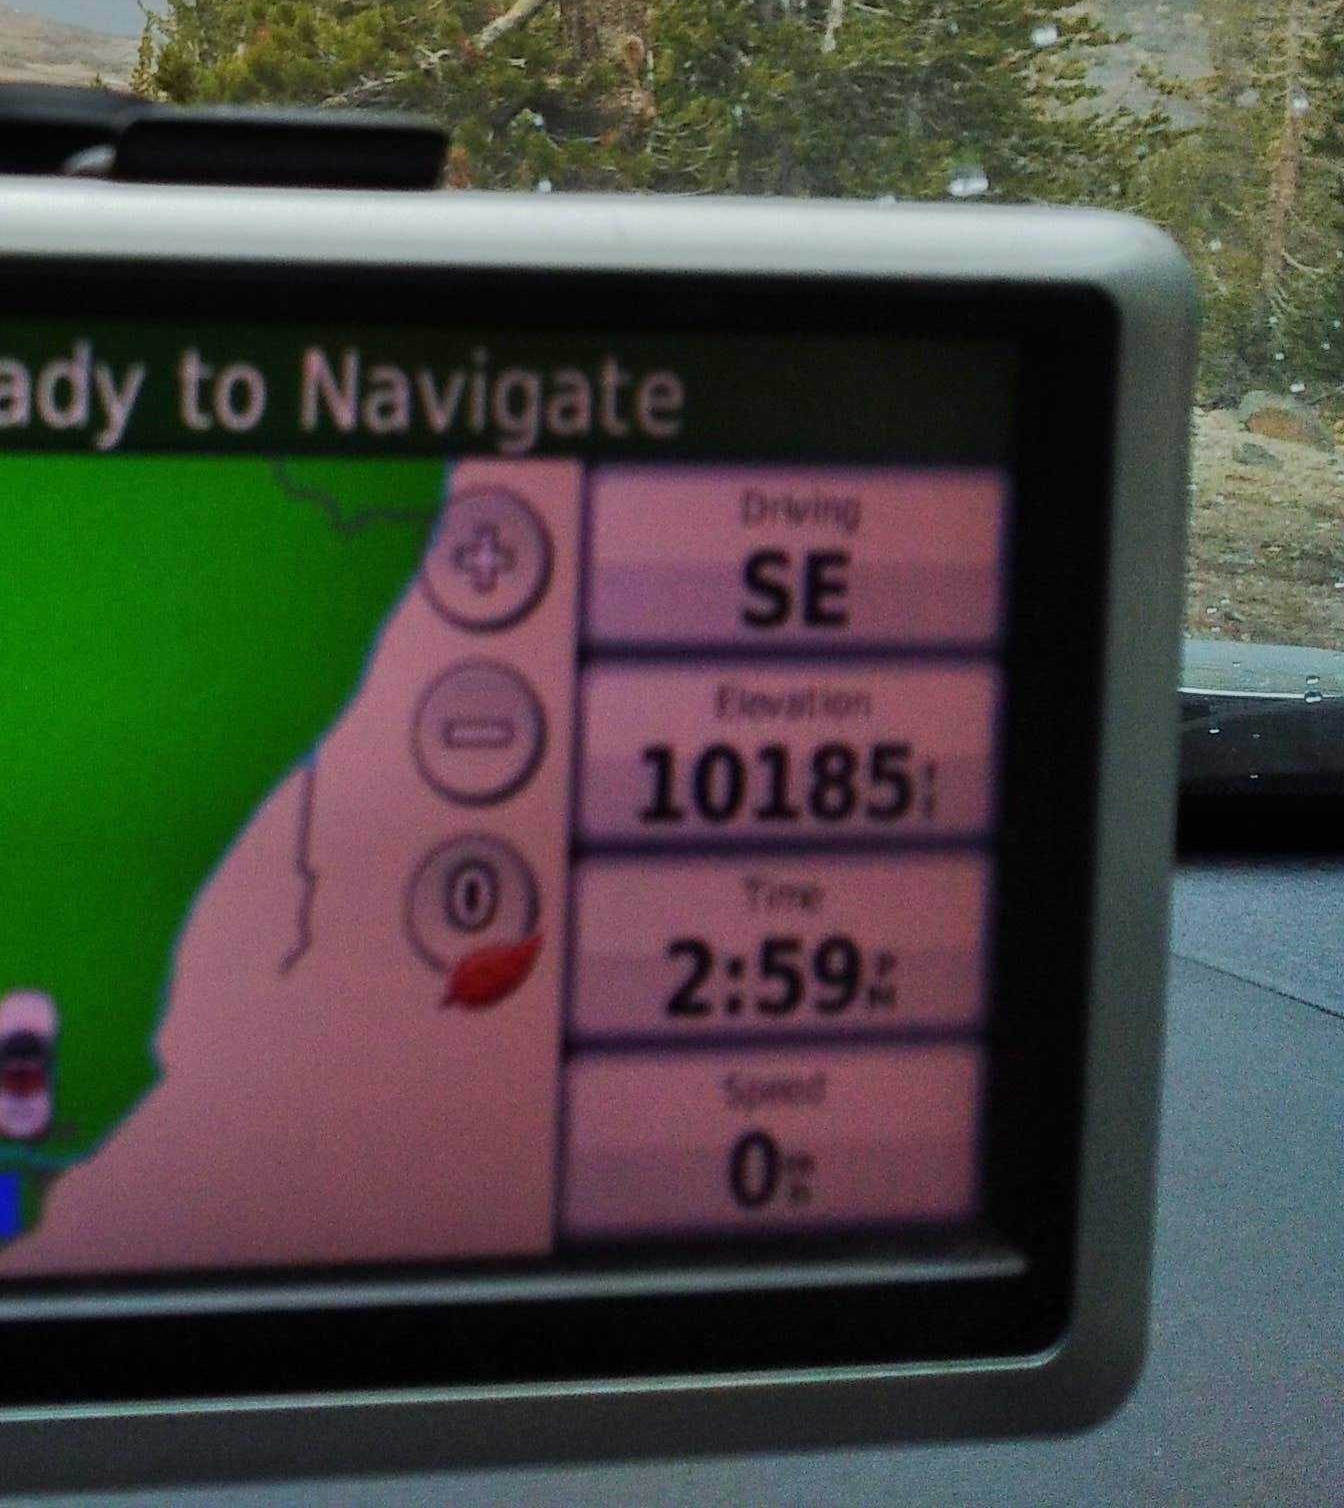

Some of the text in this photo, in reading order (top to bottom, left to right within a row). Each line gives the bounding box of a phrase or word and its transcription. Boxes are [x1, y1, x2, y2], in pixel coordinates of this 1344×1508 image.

[179, 344, 268, 433] to
[299, 345, 687, 455] Navigate
[740, 489, 864, 534] Driving
[740, 547, 853, 629] SE
[716, 684, 872, 721] Elevation
[637, 741, 915, 824] 10185
[664, 936, 862, 1018] 2:59
[727, 1129, 781, 1209] 0
